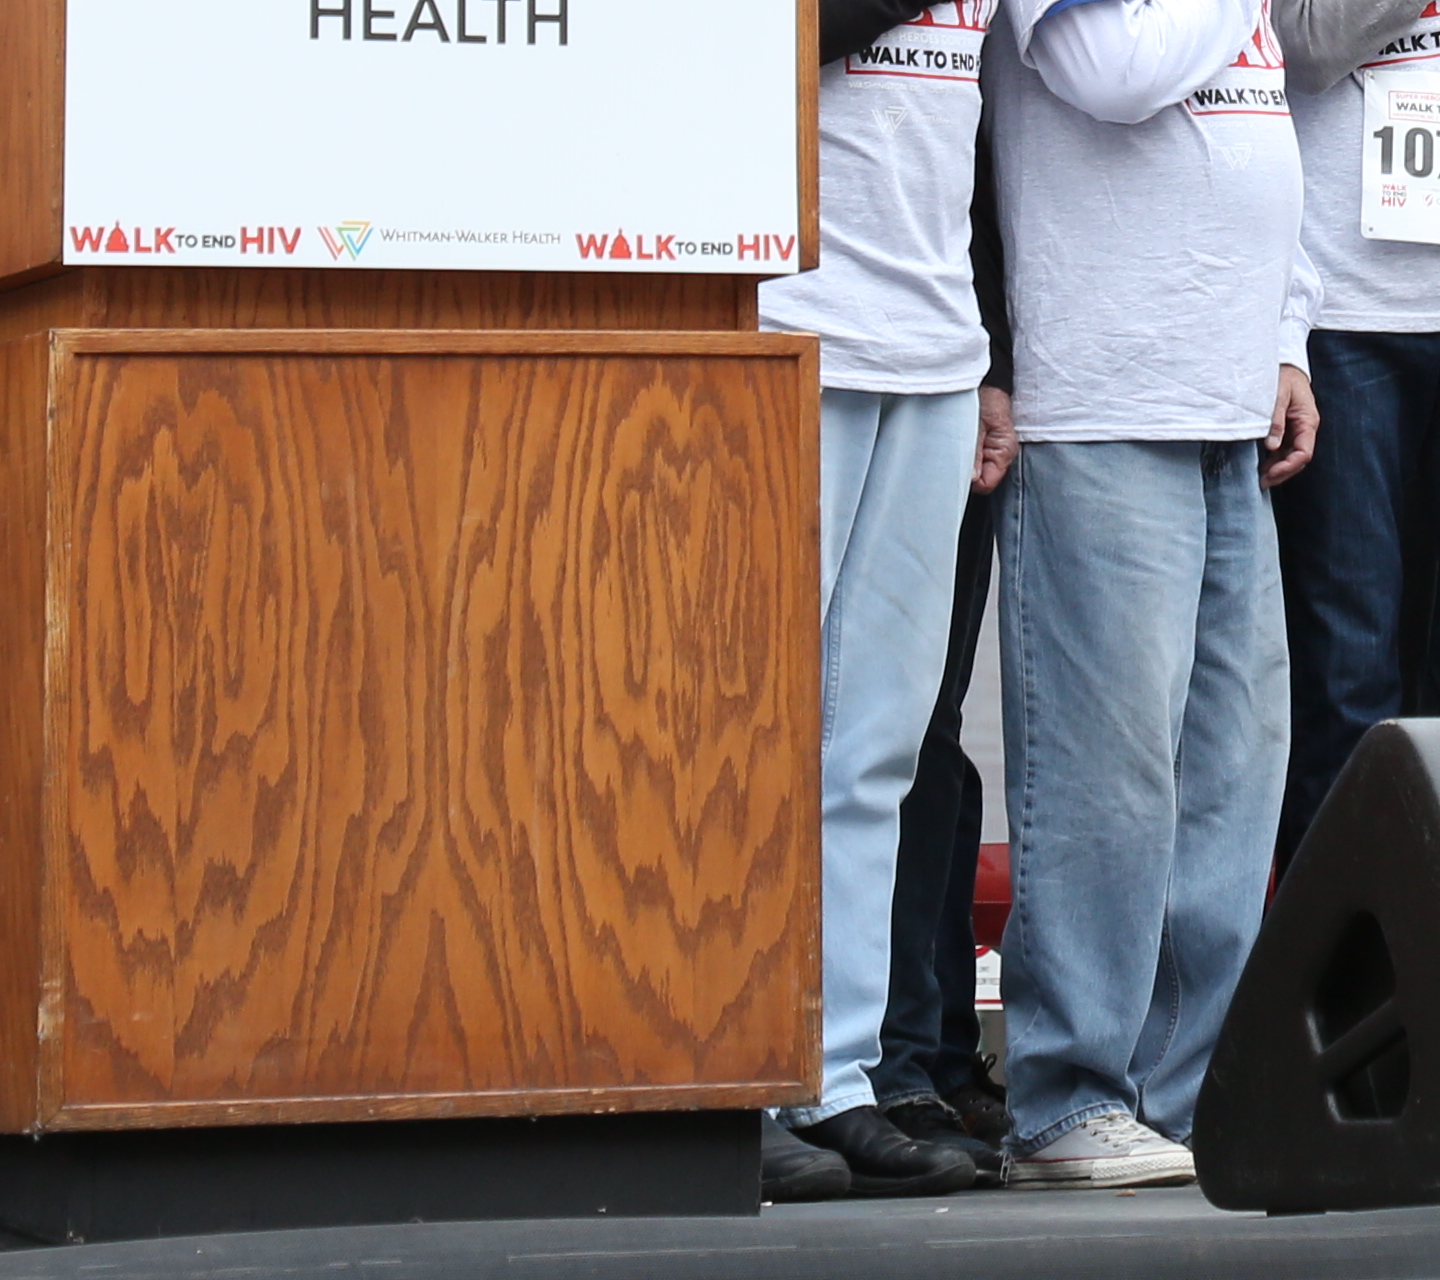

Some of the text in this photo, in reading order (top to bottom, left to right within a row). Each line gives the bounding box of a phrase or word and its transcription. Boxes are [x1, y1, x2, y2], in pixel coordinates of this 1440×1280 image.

[860, 46, 975, 73] WALK TO END
[1193, 88, 1250, 107] WALK
[1249, 89, 1269, 106] TO
[1396, 101, 1433, 114] WALK
[1381, 197, 1407, 207] HIV
[175, 234, 198, 248] TO
[202, 235, 236, 249] END
[240, 227, 302, 255] HIV
[380, 228, 561, 245] WHITMAN-WALKER HEALTH
[675, 242, 697, 255] TO
[701, 242, 733, 256] END
[737, 234, 796, 261] HIV
